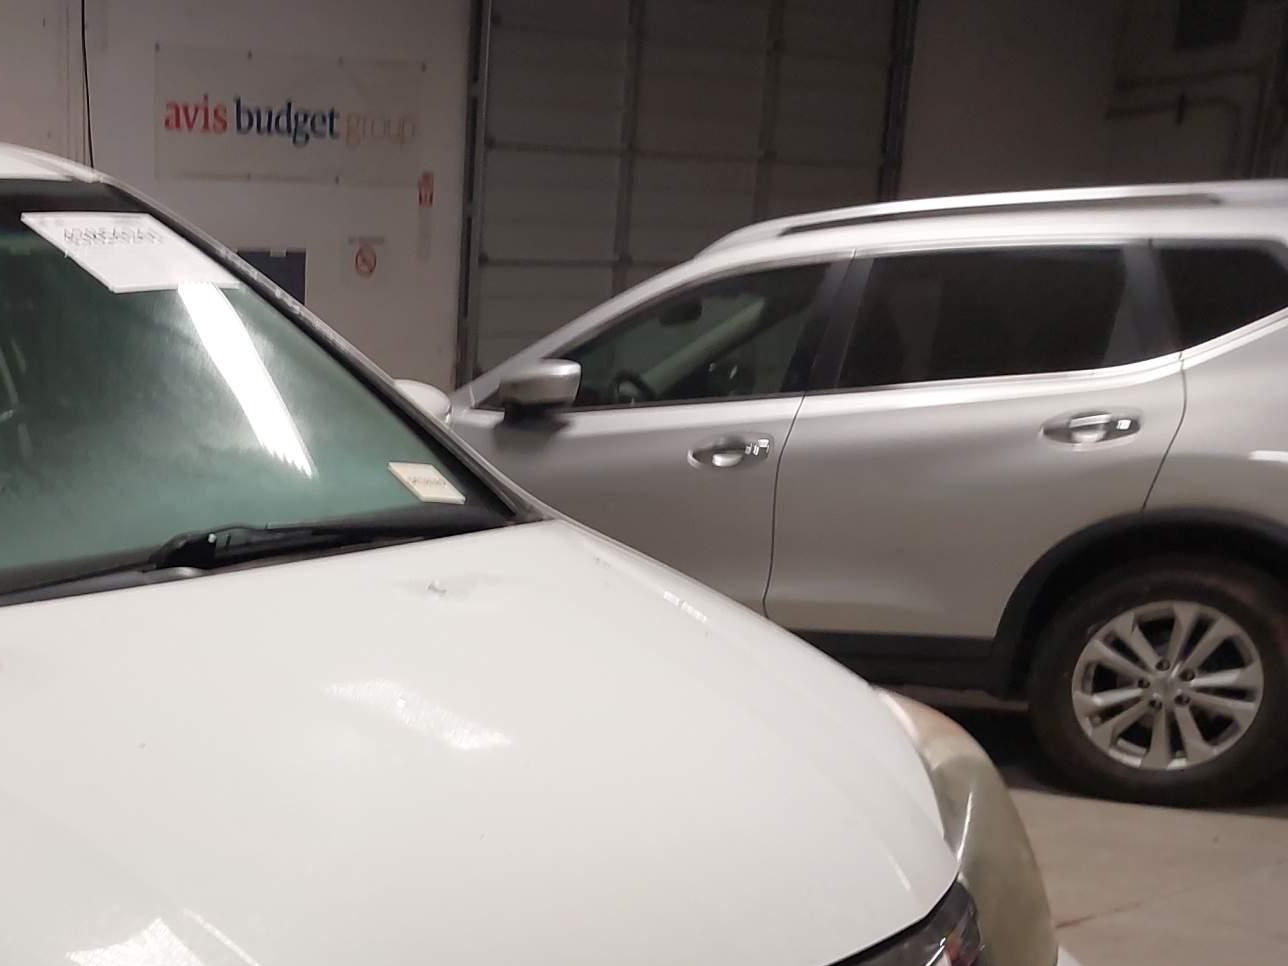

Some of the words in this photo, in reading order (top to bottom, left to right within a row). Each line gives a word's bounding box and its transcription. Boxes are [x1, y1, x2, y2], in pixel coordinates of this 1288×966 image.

[165, 95, 228, 134] avis
[235, 97, 340, 147] budget
[346, 112, 418, 150] group
